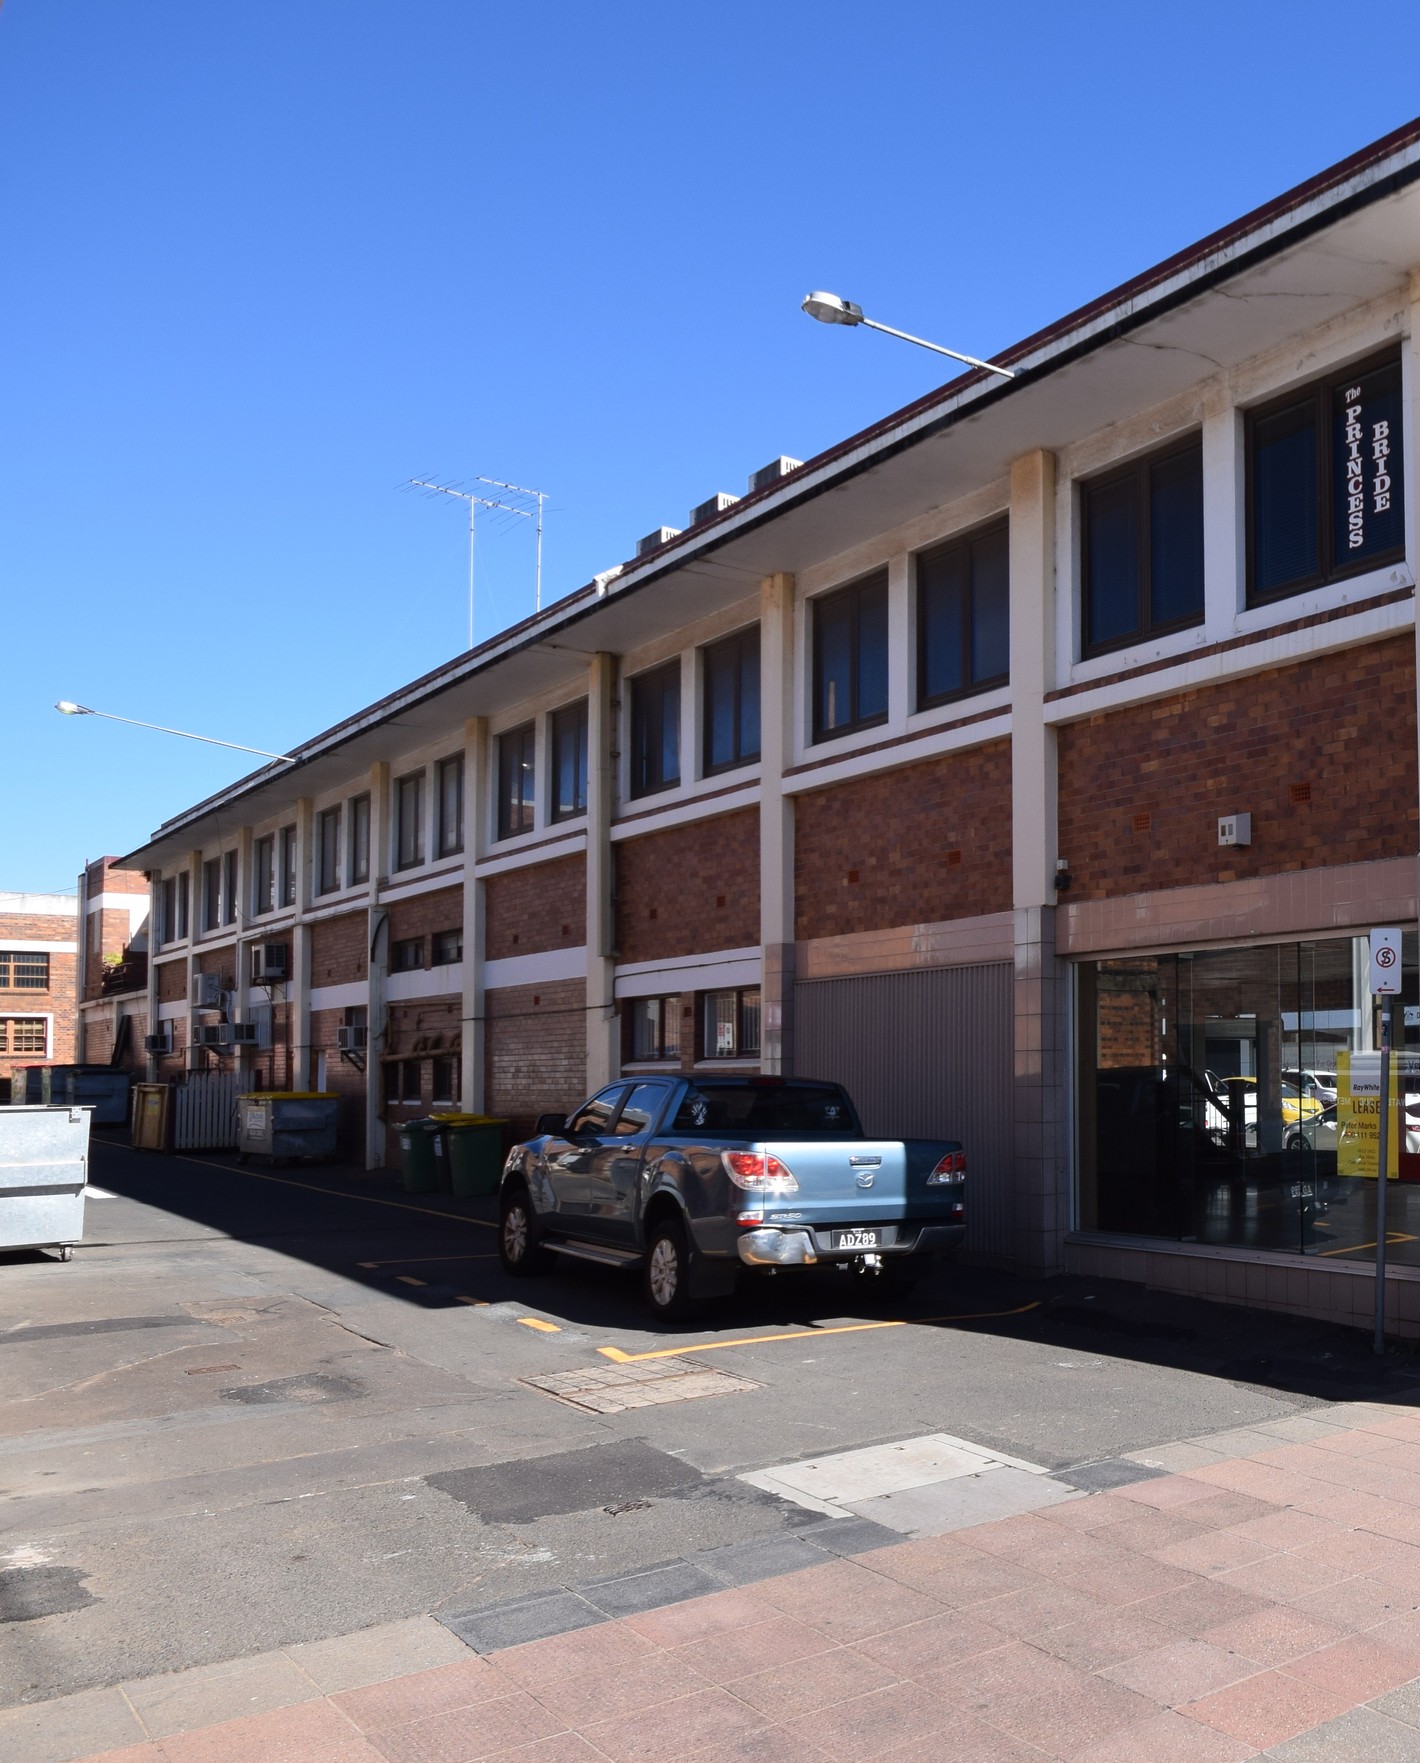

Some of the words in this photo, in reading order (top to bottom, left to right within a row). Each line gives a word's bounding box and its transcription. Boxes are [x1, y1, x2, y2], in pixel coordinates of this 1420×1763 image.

[1345, 386, 1361, 403] The
[1372, 420, 1391, 513] BRIDE
[1345, 405, 1364, 548] PRINCESS
[1352, 1101, 1381, 1114] LEASE
[839, 1232, 876, 1247] ADZ89
